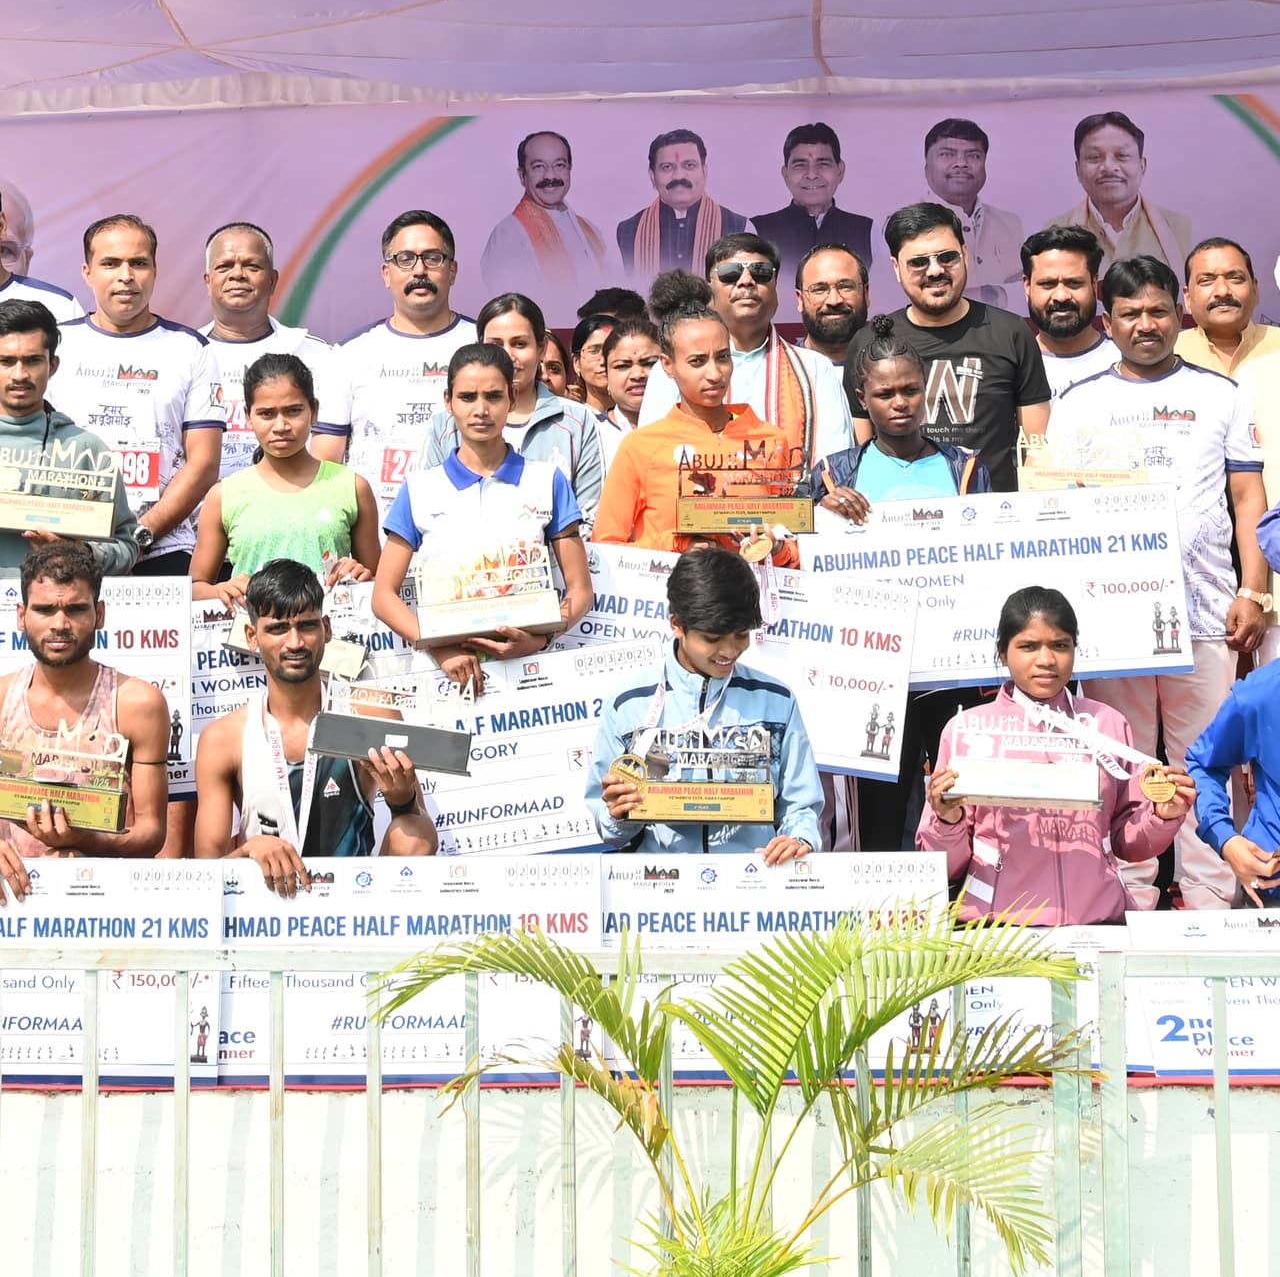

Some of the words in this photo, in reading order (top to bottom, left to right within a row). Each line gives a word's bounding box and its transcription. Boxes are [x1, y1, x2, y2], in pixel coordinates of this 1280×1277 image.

[926, 426, 950, 434] touch
[28, 471, 97, 487] MARATHON
[813, 550, 901, 573] ABUJHMAD
[906, 546, 959, 566] PEACE
[964, 543, 1005, 562] HALF
[1010, 536, 1102, 559] MARATHON
[1107, 534, 1127, 553] 21
[1131, 532, 1168, 552] KMS
[926, 594, 956, 610] Only
[114, 630, 134, 649] 10
[140, 629, 180, 649] KMS
[580, 621, 626, 638] OPEN
[840, 627, 859, 647] 10
[864, 631, 902, 653] KMS
[197, 648, 250, 670] PEACE
[201, 676, 267, 692] WOMEN
[491, 700, 588, 734] MARATHON
[435, 795, 565, 828] #RUNFORMAAD
[33, 918, 135, 938] MARATHON
[142, 918, 162, 938] 21
[168, 918, 209, 938] KMS
[288, 916, 346, 937] PEACE
[353, 915, 400, 936] HALF
[407, 914, 512, 935] MARATHON
[547, 913, 588, 933] KMS
[638, 912, 696, 933] PEACE
[703, 912, 750, 932] HALF
[42, 975, 75, 993] Only
[285, 973, 354, 988] Thousand
